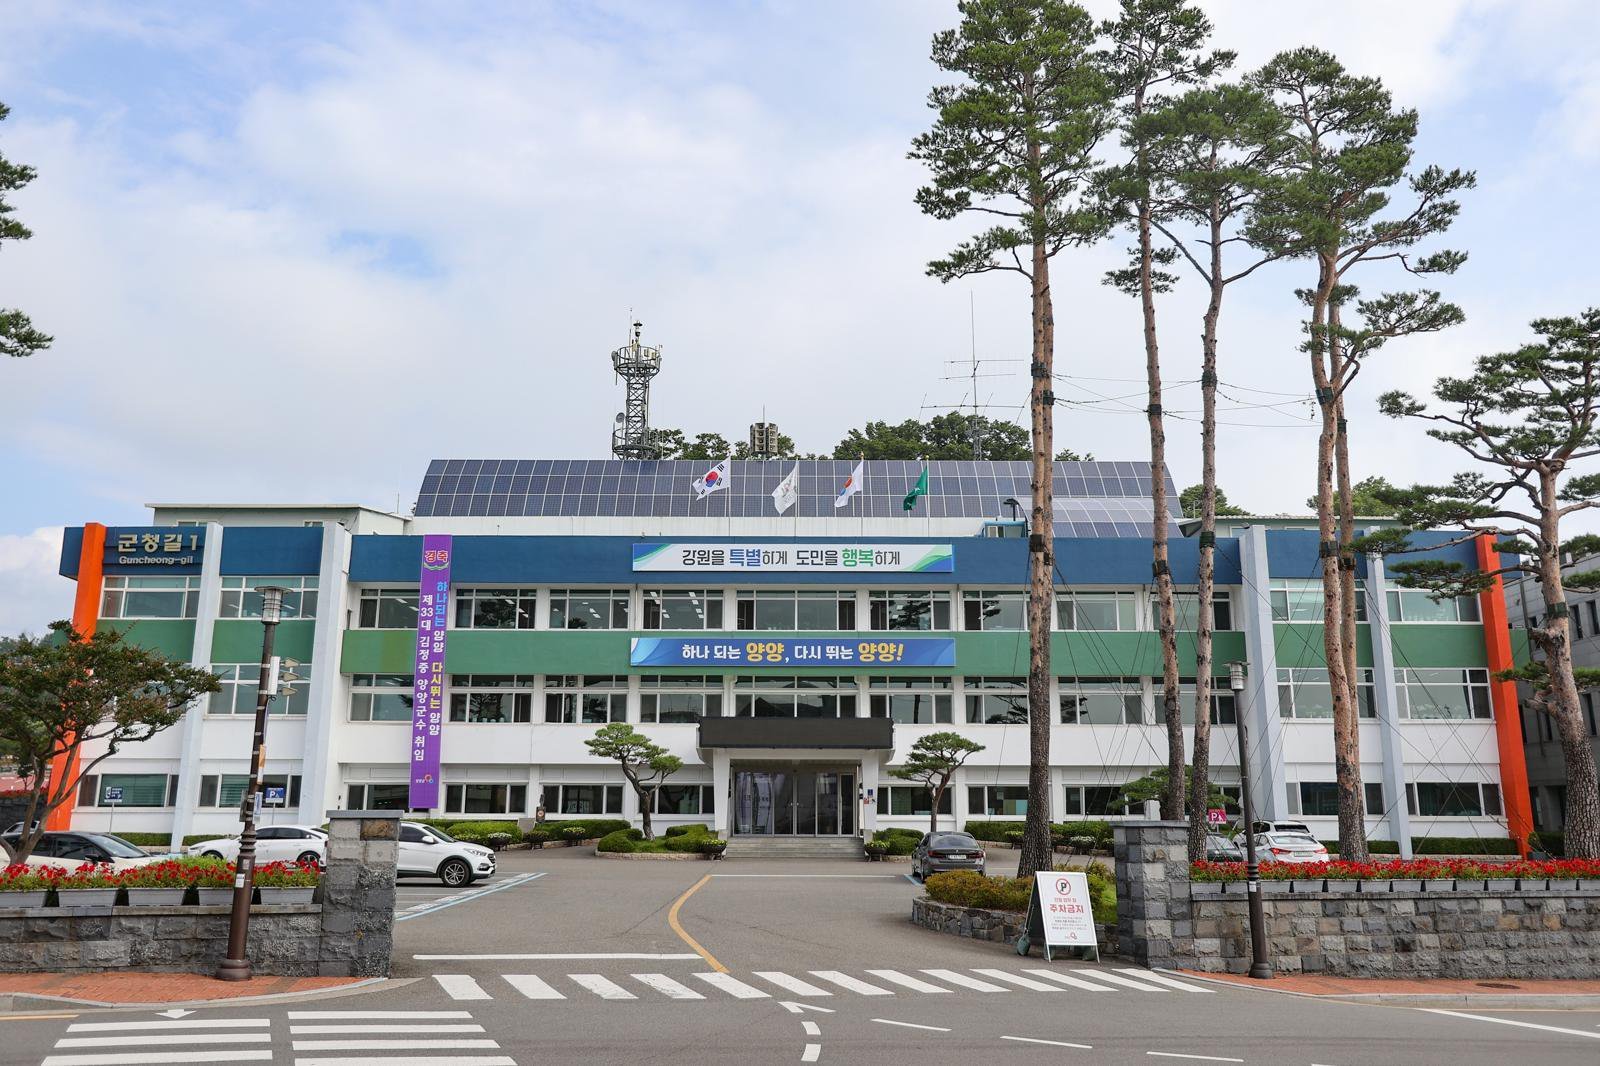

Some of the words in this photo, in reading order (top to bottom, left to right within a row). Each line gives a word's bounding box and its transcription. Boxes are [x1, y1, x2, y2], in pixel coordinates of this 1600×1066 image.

[118, 533, 182, 552] 군청길
[190, 535, 198, 551] 1
[119, 556, 193, 564] Guncheong-gil
[682, 550, 725, 566] 강원을
[729, 549, 788, 567] 특별하게
[796, 550, 838, 566] 도민을
[841, 548, 901, 567] 행복하게
[420, 594, 434, 631] 제33대
[435, 581, 448, 627] 하나되는
[433, 630, 445, 653] 양양
[682, 644, 710, 659] 하나
[713, 646, 741, 659] 되는
[746, 642, 790, 662] 양양,
[794, 646, 821, 659] 다시
[826, 646, 853, 659] 뛰는
[858, 642, 904, 662] 양양!
[430, 662, 443, 709] 다시뛰는
[415, 679, 429, 731] 양양군수
[429, 712, 441, 736] 양양
[414, 735, 425, 761] 취임
[1049, 904, 1084, 913] 주차금지
